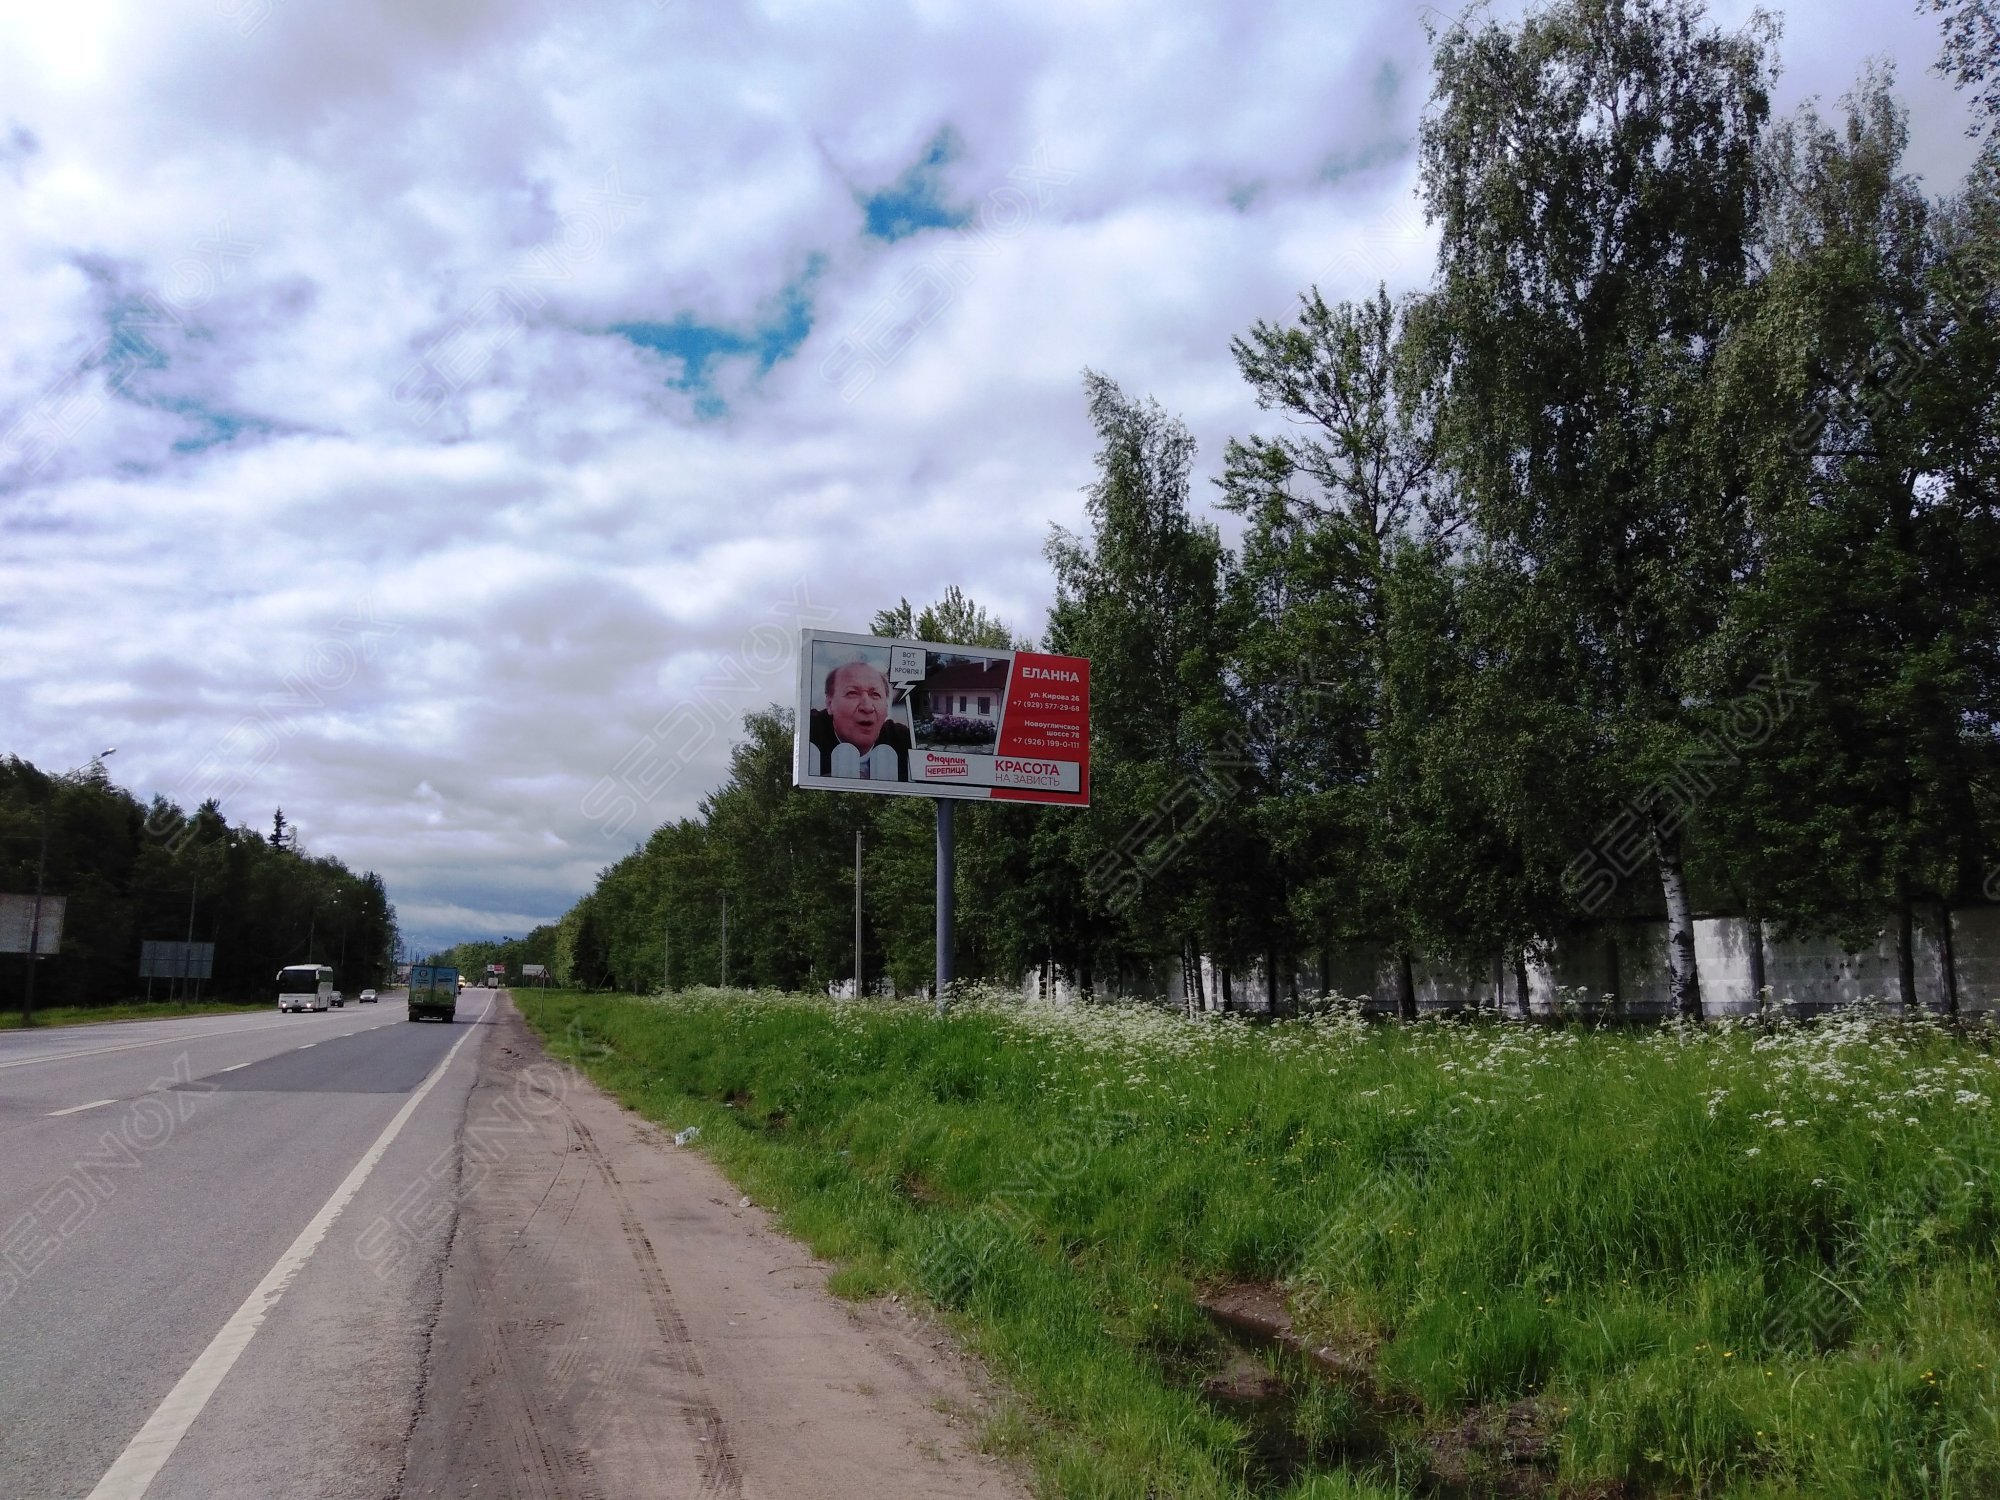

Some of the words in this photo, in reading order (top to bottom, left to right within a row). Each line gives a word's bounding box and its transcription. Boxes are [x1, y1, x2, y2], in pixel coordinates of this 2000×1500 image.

[902, 651, 916, 659] ВОТ
[1022, 667, 1080, 683] ЕЛАННА
[1042, 692, 1070, 701] Кирова
[1024, 720, 1080, 731] Новоугличское
[926, 753, 966, 766] Ондулин
[927, 767, 966, 775] ЧЕРЕПИЦА
[995, 760, 1060, 776] КРАСОТА
[995, 773, 1010, 782] НА
[1013, 775, 1060, 786] ЗАВИСТЬ
